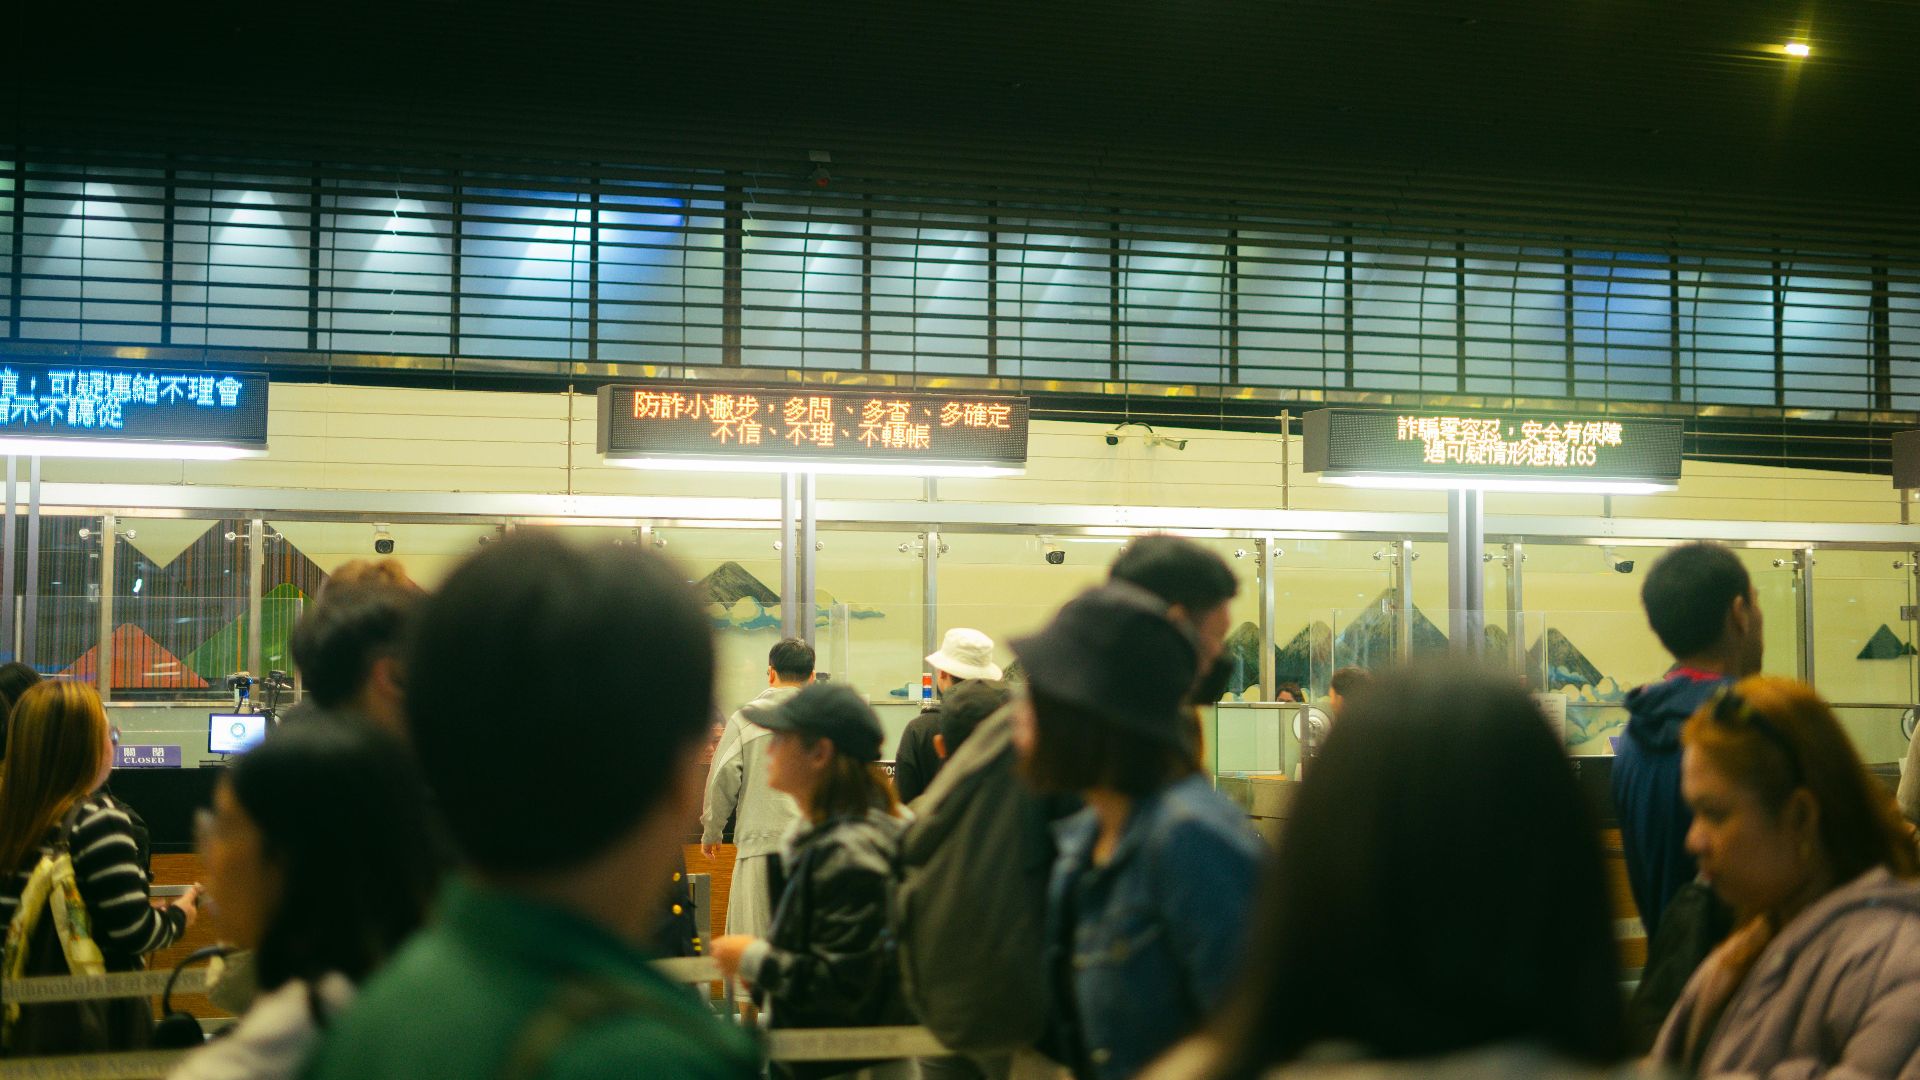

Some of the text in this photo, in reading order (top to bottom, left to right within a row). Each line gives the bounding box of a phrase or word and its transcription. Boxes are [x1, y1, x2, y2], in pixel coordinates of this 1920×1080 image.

[711, 418, 930, 450] 不信、不理、不轉帳
